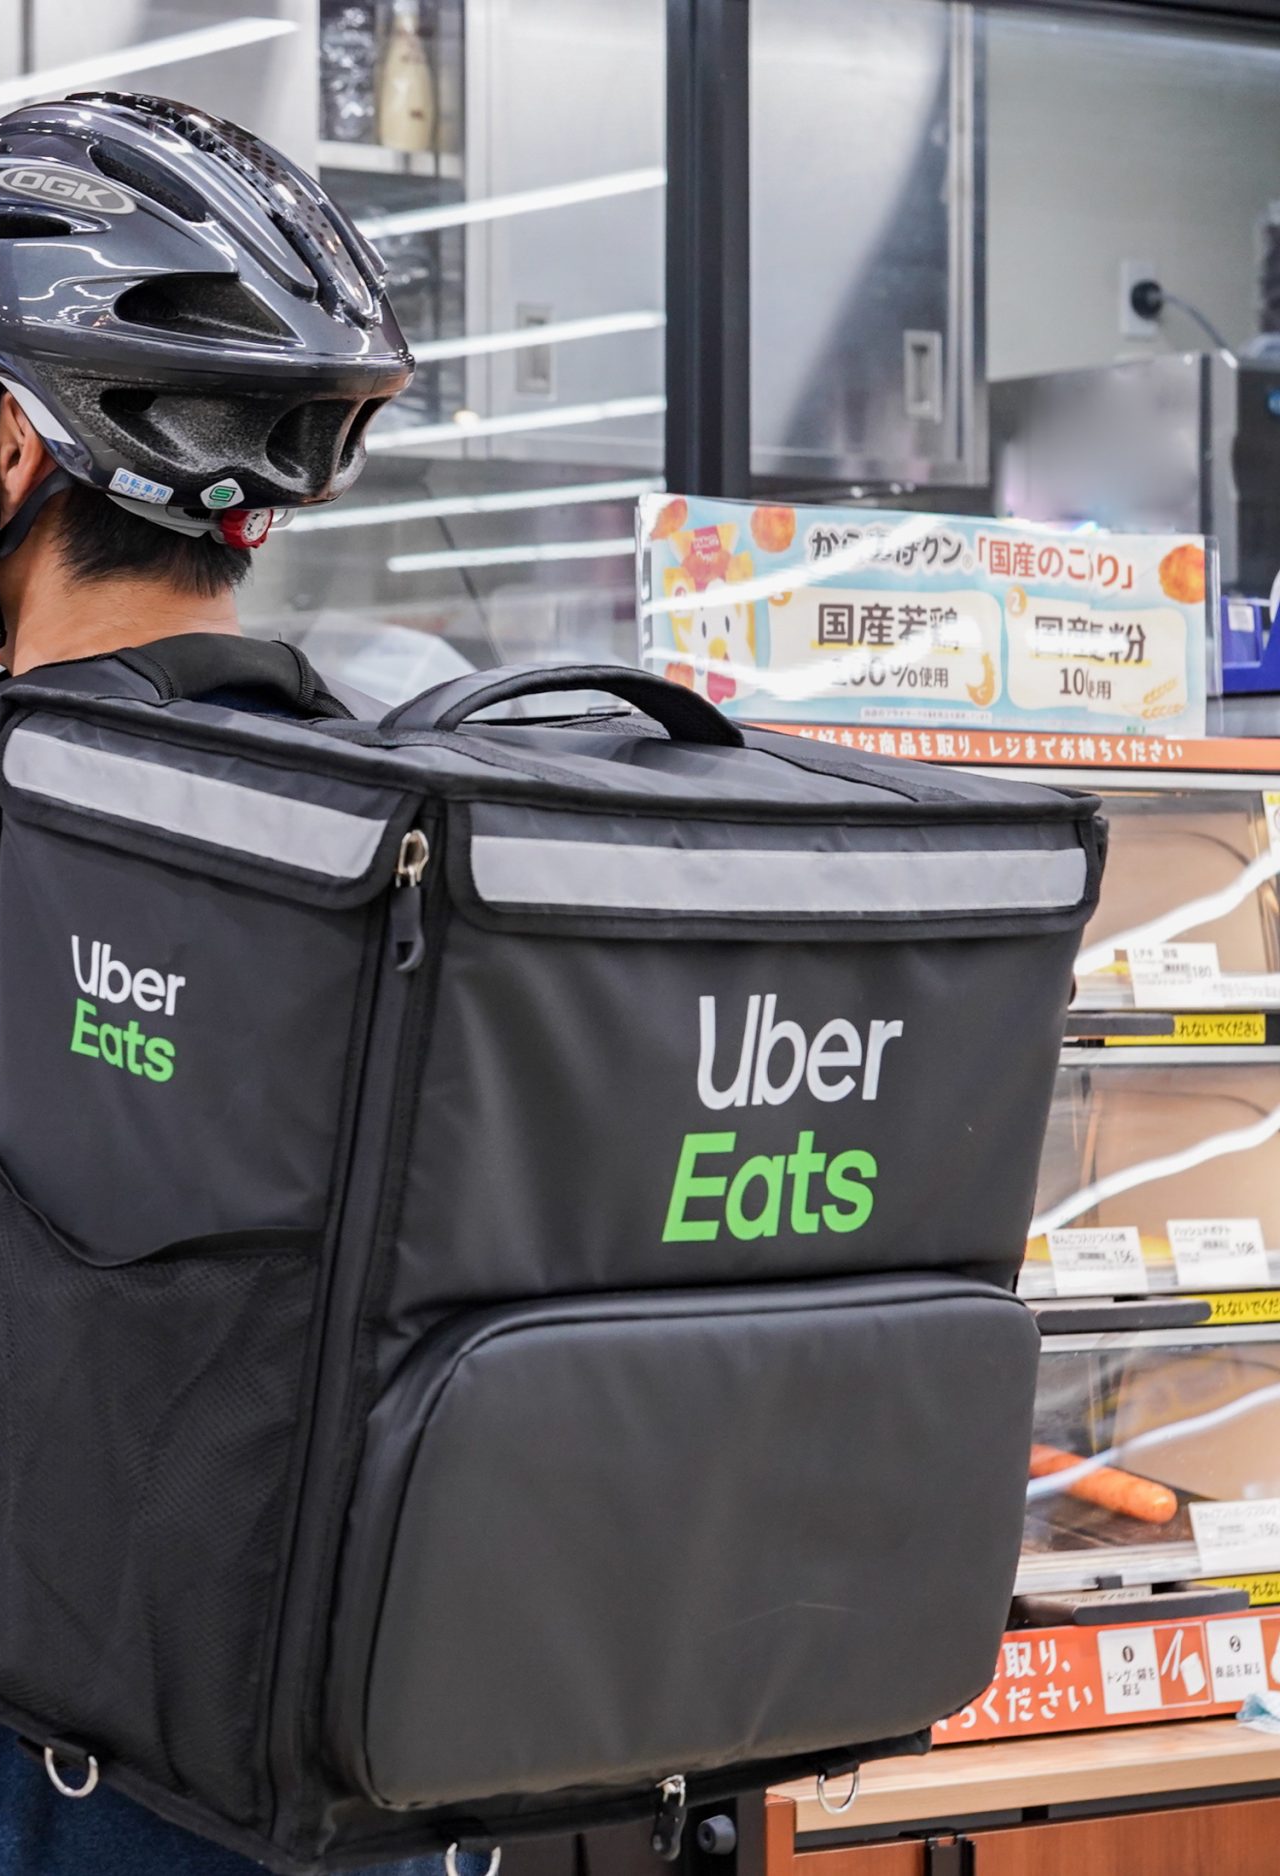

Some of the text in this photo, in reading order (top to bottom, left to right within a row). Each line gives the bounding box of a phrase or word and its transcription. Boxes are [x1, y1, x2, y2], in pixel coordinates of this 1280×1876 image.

[10, 171, 111, 207] OGK
[113, 482, 167, 503] ヘルメット
[117, 473, 167, 498] 自転車用
[71, 935, 186, 1016] Uber
[70, 998, 176, 1082] Eats
[696, 993, 904, 1110] Uber
[661, 1130, 878, 1242] Eats
[993, 1638, 1072, 1681] 取り、
